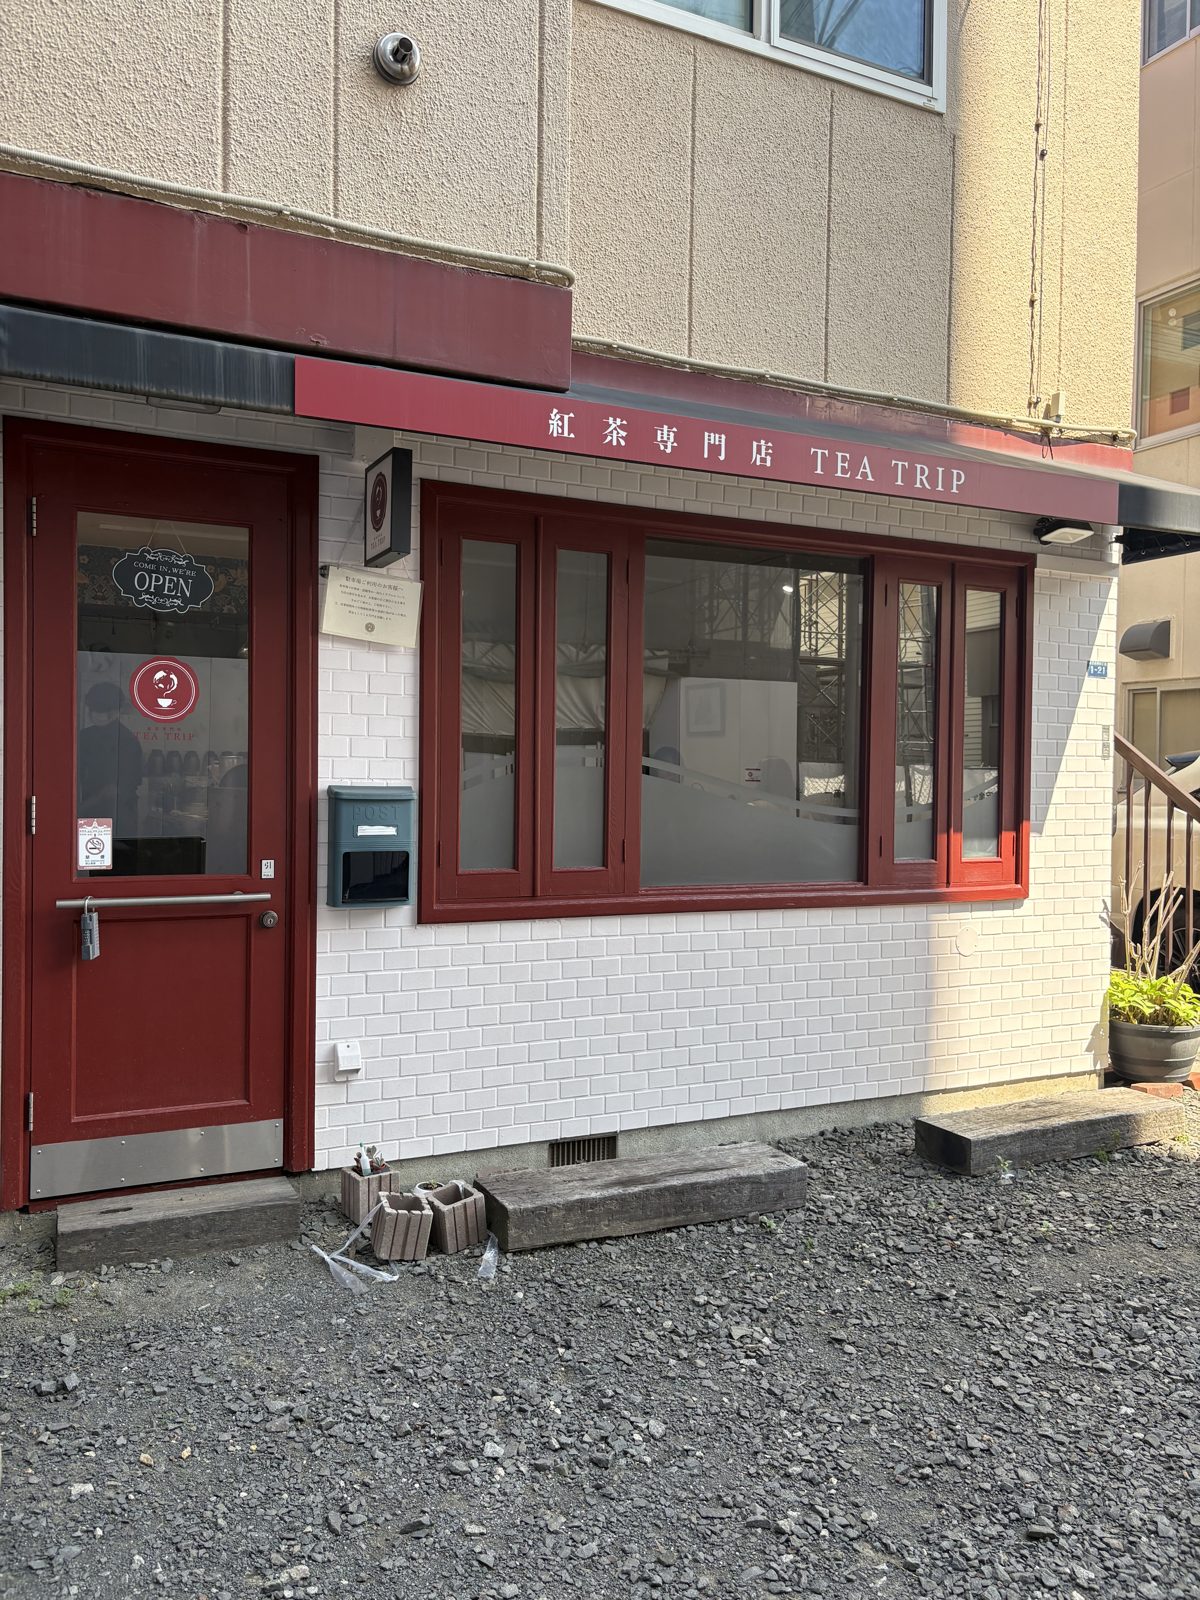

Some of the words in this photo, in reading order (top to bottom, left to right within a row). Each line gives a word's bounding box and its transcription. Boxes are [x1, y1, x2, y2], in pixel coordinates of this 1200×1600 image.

[548, 407, 774, 468] 紅茶専門店
[810, 447, 875, 482] TEA
[891, 459, 966, 494] TRIP
[133, 561, 157, 571] COME
[134, 571, 193, 598] OPEN
[1090, 665, 1106, 676] 1-21
[133, 731, 159, 741] TEA
[165, 731, 195, 741] TRIP
[352, 805, 400, 821] POST
